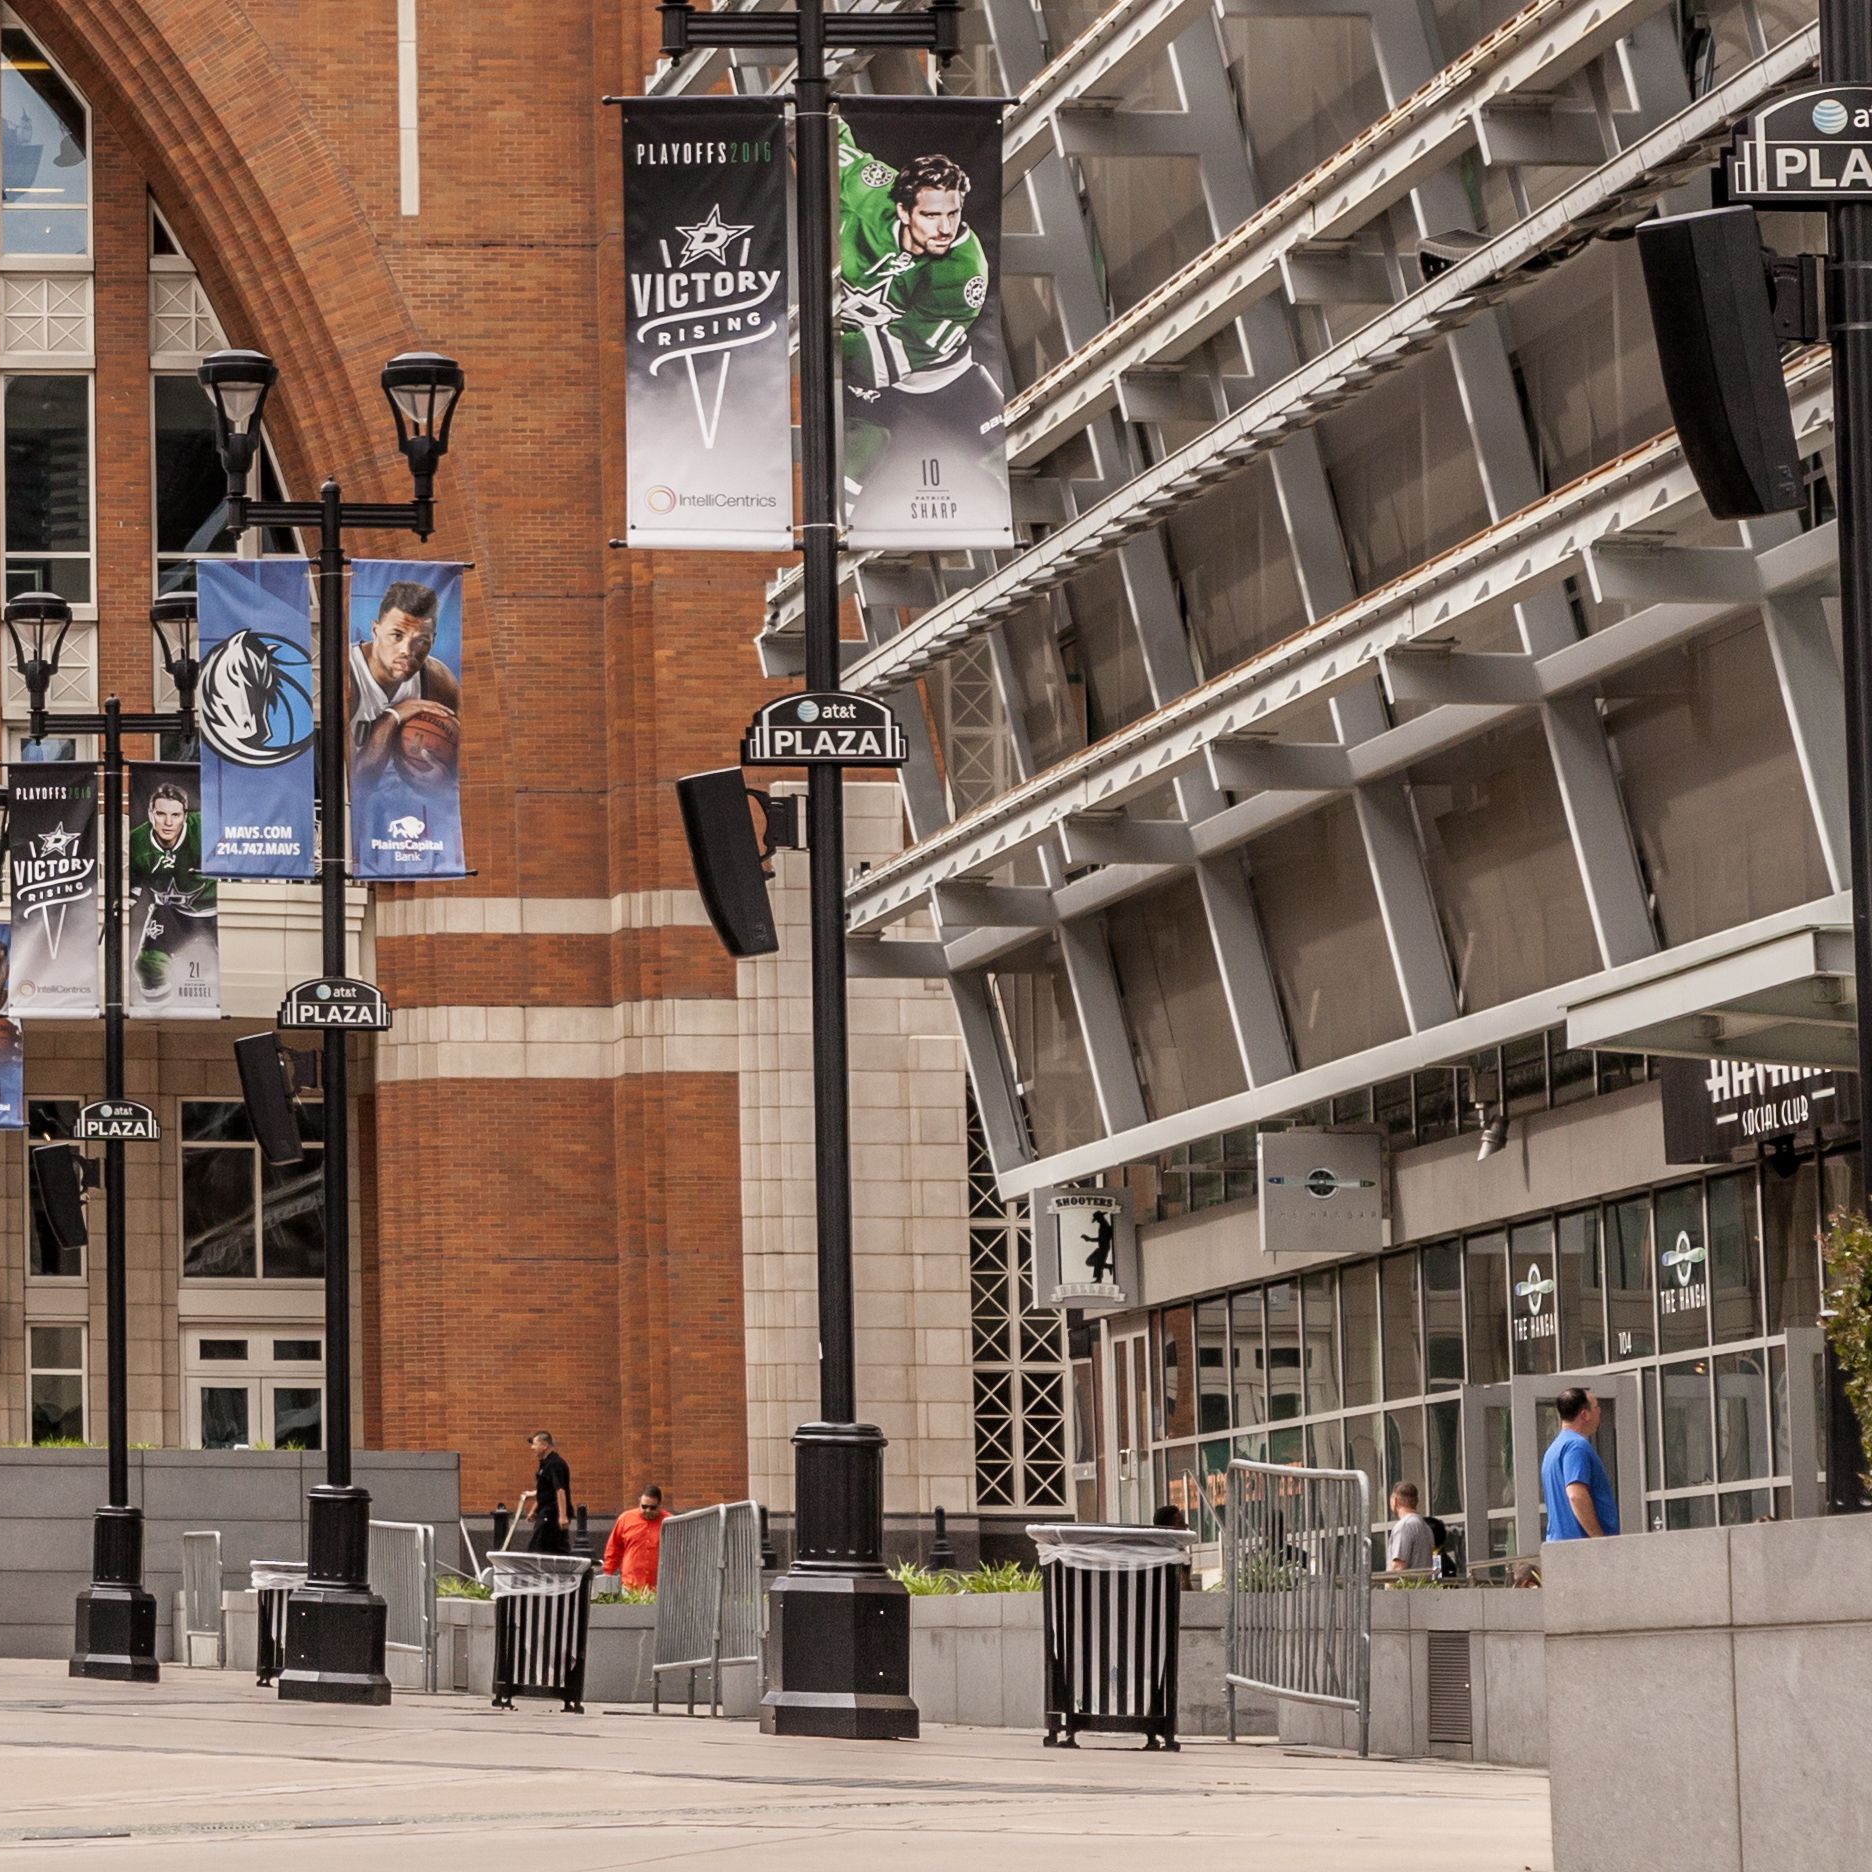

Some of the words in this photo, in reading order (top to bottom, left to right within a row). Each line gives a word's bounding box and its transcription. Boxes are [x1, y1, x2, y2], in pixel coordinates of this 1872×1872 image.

[636, 141, 772, 165] PLAYOFFS2016
[631, 270, 781, 318] VICTORY
[658, 312, 761, 346] RISING
[921, 458, 940, 486] 10
[679, 492, 777, 508] IntelliCentrics
[911, 502, 957, 519] SHARP
[822, 703, 857, 719] at&t
[774, 730, 882, 755] PLAZA
[224, 826, 293, 839] MAVS.COM
[216, 842, 301, 856] 214.747.MAVS
[371, 839, 444, 852] PlainsCapital
[394, 851, 422, 862] Bank
[13, 858, 95, 886] VICTORY
[28, 882, 84, 903] RISING
[189, 961, 201, 978] 21
[37, 984, 92, 995] IntelliCentrics
[333, 987, 358, 998] at&t
[299, 1005, 374, 1024] PLAZA
[1742, 1103, 1780, 1137] SOCIAL
[1781, 1094, 1809, 1127] CLUB
[87, 1121, 147, 1136] PLAZA
[1055, 1196, 1114, 1208] SHOOTERS
[1660, 1288, 1677, 1315] THE
[1678, 1282, 1706, 1312] HANGA
[1513, 1317, 1528, 1341] THE
[1530, 1312, 1555, 1339] HANGA
